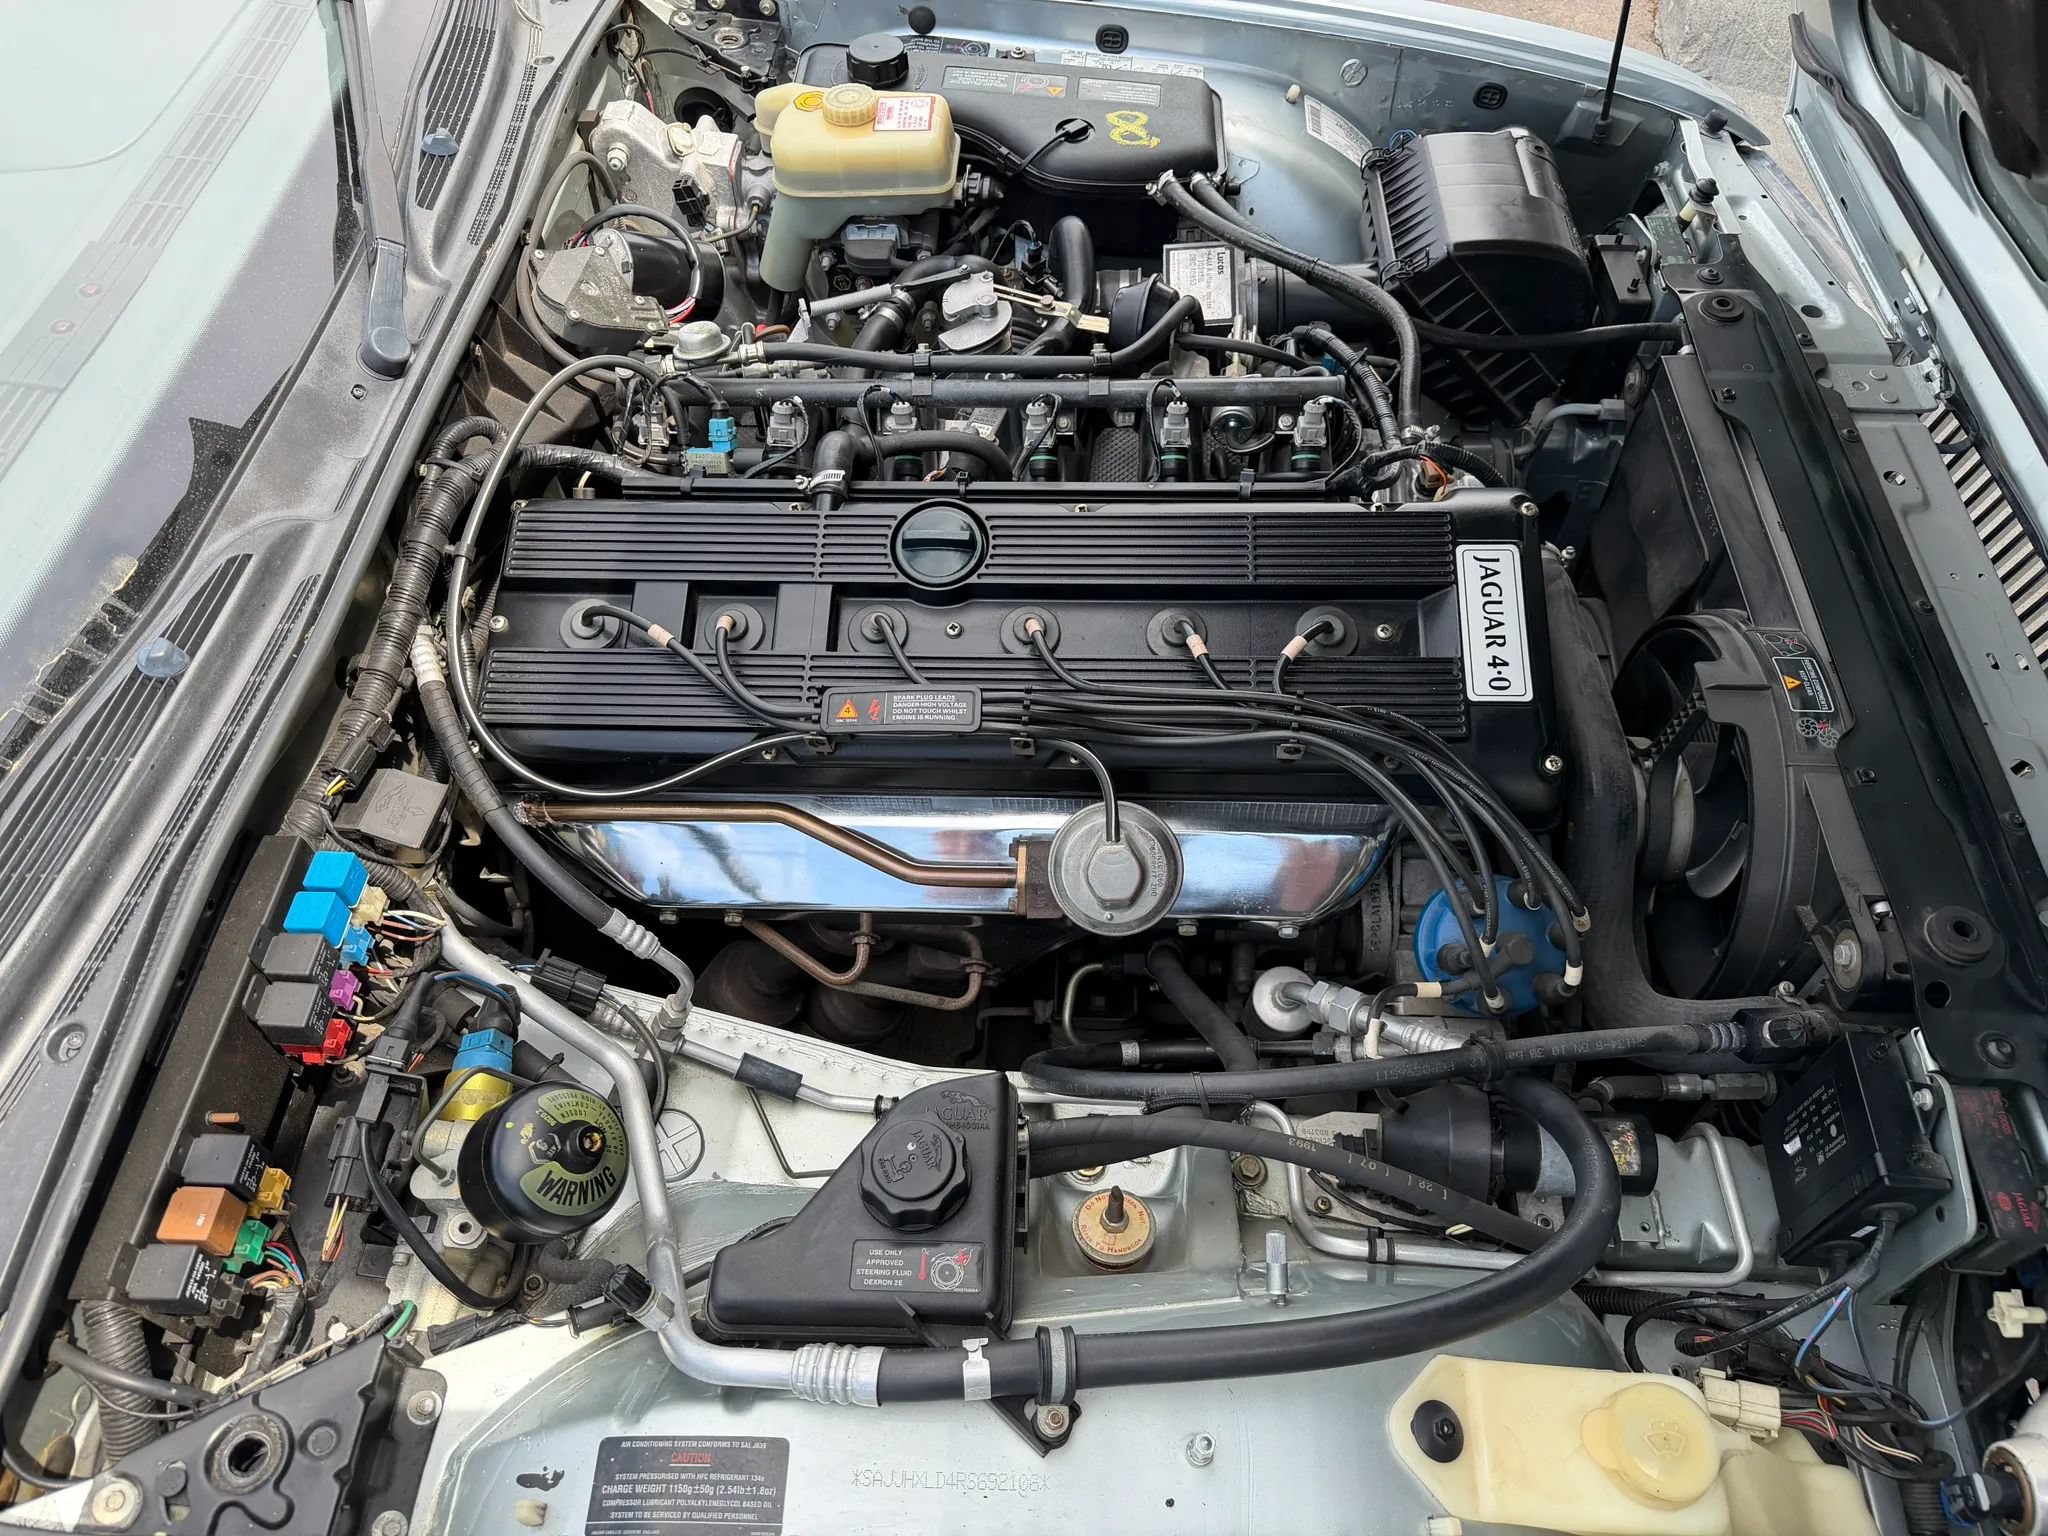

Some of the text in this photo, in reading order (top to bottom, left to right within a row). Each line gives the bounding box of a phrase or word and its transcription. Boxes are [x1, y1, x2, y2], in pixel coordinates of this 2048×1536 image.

[1217, 251, 1226, 275] Lucas
[1473, 555, 1507, 649] JAGUAR
[845, 706, 851, 715] 4
[560, 1110, 588, 1119] LOOSEN
[1288, 1137, 1317, 1152] 1993
[909, 1130, 937, 1170] JAGUAR
[536, 1165, 617, 1206] WARNING
[671, 1452, 712, 1463] CAUTION
[709, 1473, 750, 1481] REFRIGERANT
[751, 1474, 765, 1482] 134a
[602, 1484, 633, 1494] CHARGE
[635, 1484, 666, 1494] WEIGHT
[602, 1499, 642, 1507] COMPRESSOR
[642, 1499, 675, 1507] LUBRICANT
[676, 1499, 741, 1508] POLYALKYLENEGLYCOL
[742, 1500, 762, 1508] BASED
[610, 1511, 758, 1521] SYSTEM TO BE SERVICED BY QUALIFIED PERSONNEL
